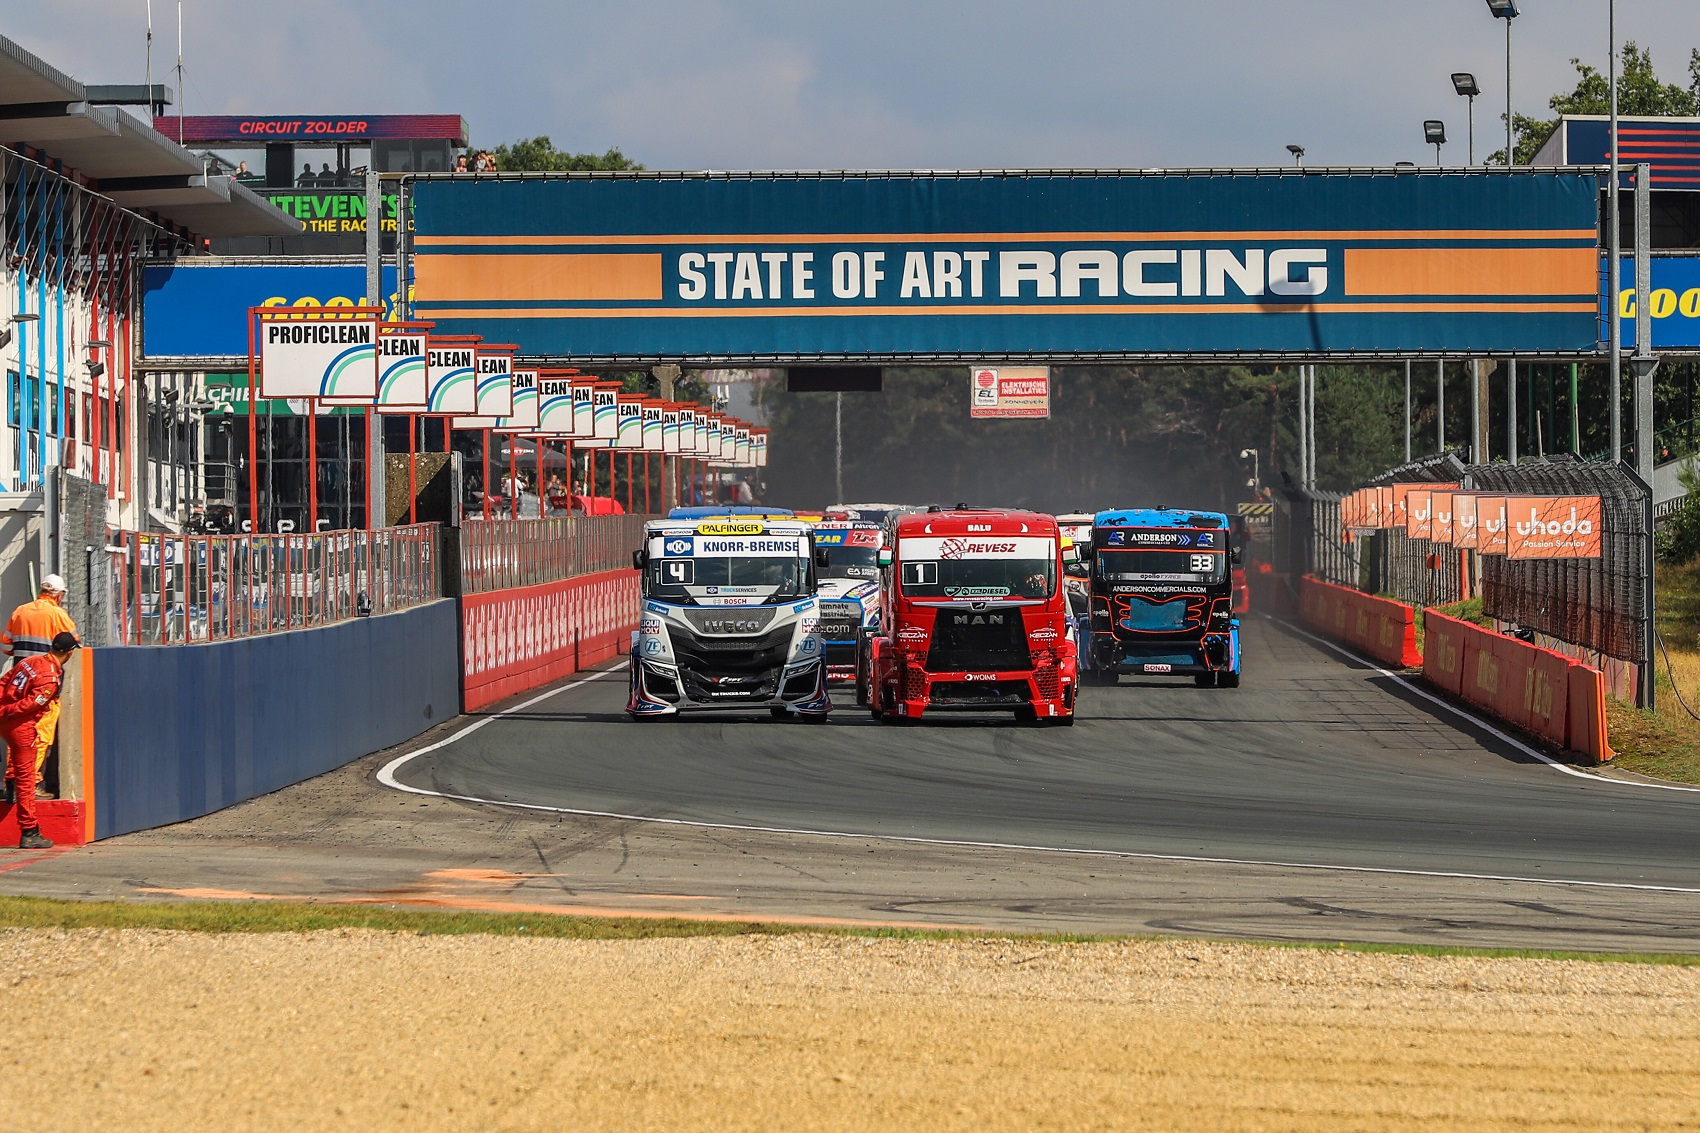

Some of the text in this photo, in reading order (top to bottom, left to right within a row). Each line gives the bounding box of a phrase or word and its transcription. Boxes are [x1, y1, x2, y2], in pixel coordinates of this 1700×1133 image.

[239, 121, 368, 134] CIRCUIT ZOLDER
[309, 219, 337, 232] THE
[677, 248, 1328, 301] STATE OF ART RACING
[269, 325, 370, 344] PROFICLEAN
[428, 351, 471, 367] CLEAN
[1516, 506, 1592, 536] uhoda
[702, 524, 759, 533] PALFINGER
[967, 524, 992, 532] BALU
[1131, 533, 1177, 542] ANDERSON
[1523, 539, 1586, 548] Passion Service
[703, 541, 799, 552] KNORR-BREMSE
[1192, 556, 1212, 570] 33
[669, 563, 685, 582] 4
[915, 564, 924, 583] 1
[703, 620, 760, 633] IVECO
[953, 615, 1003, 625] MAN
[1145, 664, 1170, 672] SONAX
